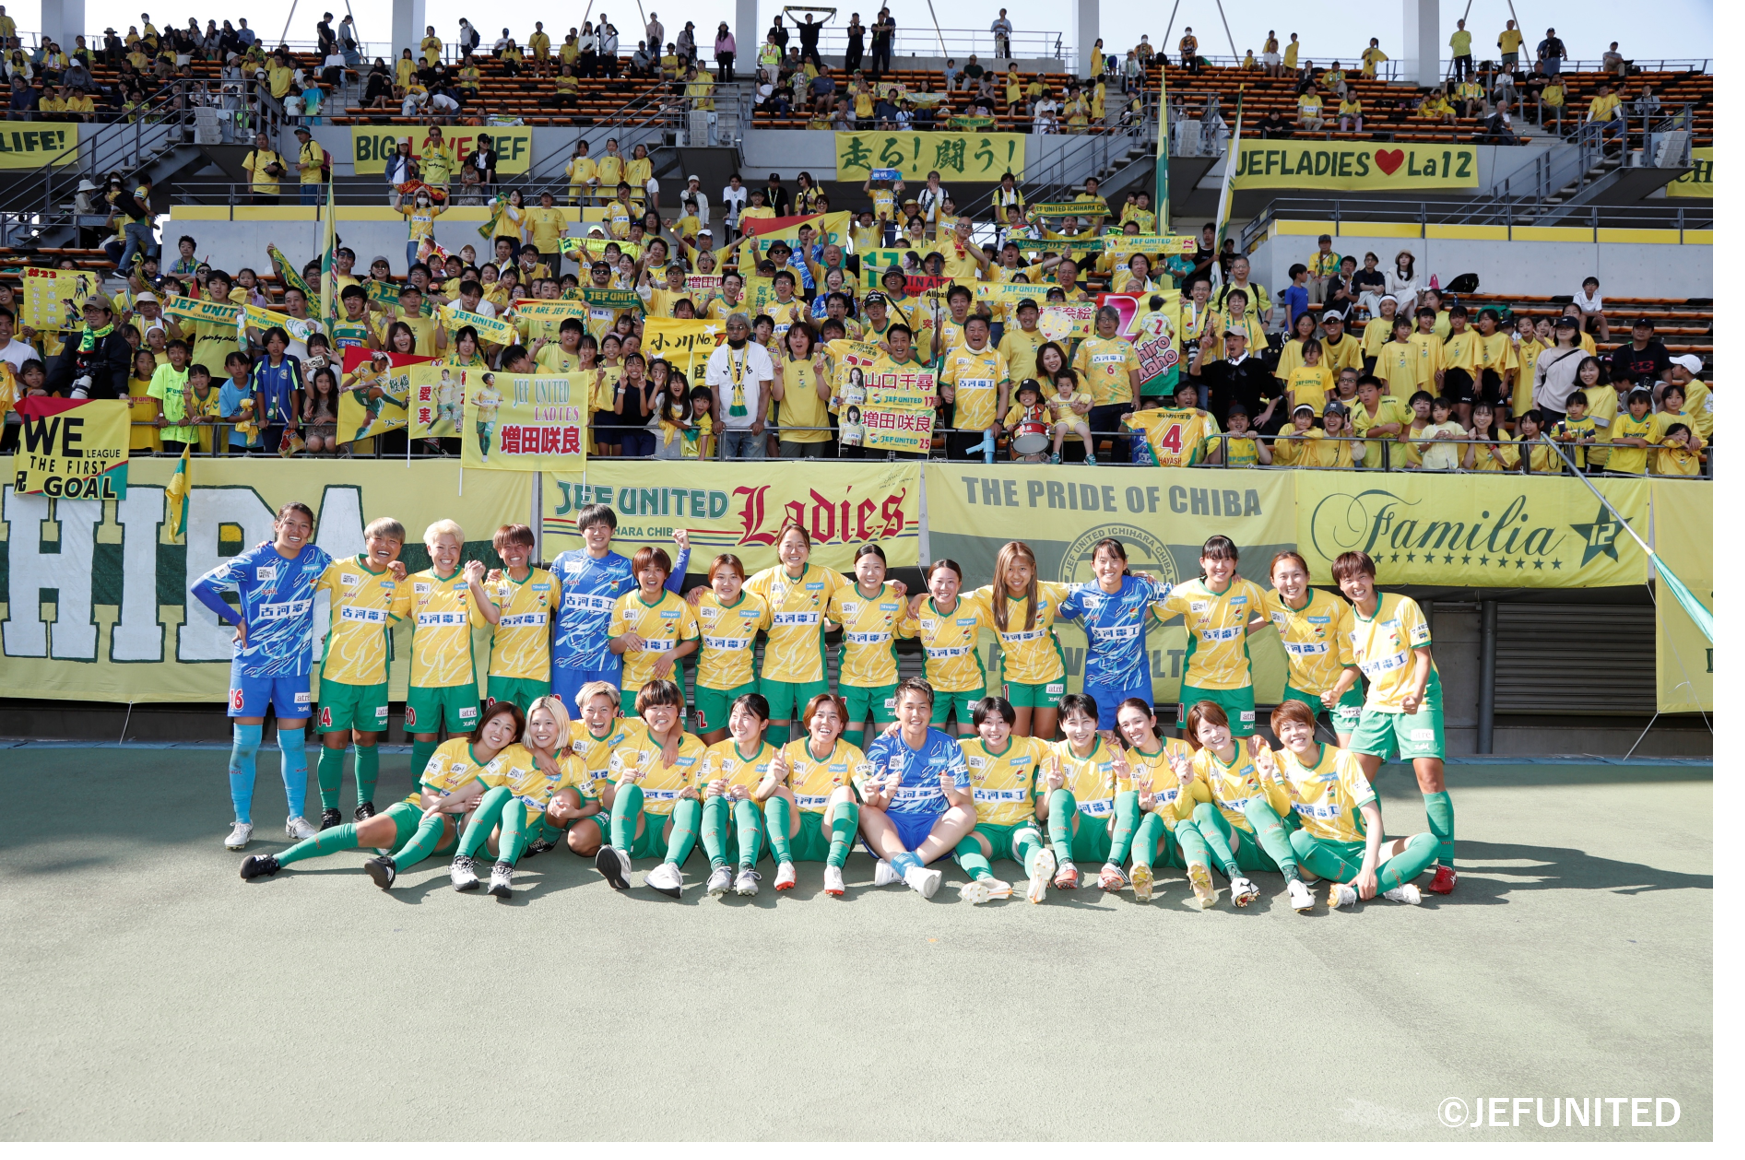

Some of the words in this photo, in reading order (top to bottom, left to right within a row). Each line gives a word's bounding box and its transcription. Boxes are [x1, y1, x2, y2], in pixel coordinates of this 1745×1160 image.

[0, 131, 65, 152] LIFE!
[356, 135, 396, 161] BIG
[1236, 149, 1370, 176] JEFLADIES
[1043, 204, 1067, 212] UNITED
[28, 268, 57, 279] #23
[589, 291, 608, 301] JEF
[610, 291, 639, 300] UNITE
[1001, 285, 1018, 293] JEF
[1019, 285, 1048, 293] UNITED
[169, 298, 199, 311] JEF
[535, 306, 550, 314] ARE
[551, 307, 565, 315] JEF
[566, 307, 583, 316] FAM
[257, 317, 284, 329] UNITED
[452, 309, 472, 322] JEF
[472, 314, 506, 331] UNITED
[1083, 324, 1090, 334] 4
[651, 333, 694, 352] 小川
[696, 333, 712, 345] No.
[714, 334, 727, 347] 7
[1107, 364, 1115, 375] 6
[865, 372, 933, 390] 山口千尋
[959, 380, 994, 388] 古河電工
[513, 379, 529, 408] JEF
[535, 379, 570, 405] UNITED
[898, 396, 922, 404] UNITED
[924, 396, 934, 407] 17
[534, 406, 579, 422] LADIES
[862, 411, 931, 433] 増田咲良
[24, 413, 84, 458] WE
[501, 425, 581, 455] 増田咲良
[880, 435, 894, 444] JEF
[894, 436, 918, 445] UNITED
[919, 438, 930, 450] 25
[1161, 423, 1183, 454] 4
[86, 449, 121, 458] LEAGUE
[30, 455, 56, 473] THE
[67, 460, 107, 475] FIRST
[43, 476, 116, 499] GOAL
[961, 476, 1020, 507] THE
[1027, 480, 1117, 512] PRIDE
[1126, 486, 1160, 513] OF
[1169, 485, 1262, 516] CHIBA
[554, 479, 614, 516] JEF
[617, 487, 729, 519] UNITED
[732, 484, 907, 546] Ladies
[615, 526, 644, 537] HARA
[647, 526, 677, 537] CHIB
[1311, 489, 1567, 562] Familia
[1589, 522, 1616, 547] 12
[1065, 553, 1076, 572] JEF
[1074, 529, 1106, 553] UNITED
[1107, 526, 1156, 547] ICHIHARA
[1155, 545, 1174, 576] CHIBA
[566, 594, 614, 611] 古河電工
[343, 607, 388, 622] 古河電工
[418, 613, 467, 626] 古河電工
[501, 614, 547, 627] 古河電工
[774, 613, 819, 625] 古河電工
[847, 632, 890, 642] 古河電工
[1093, 626, 1139, 639] 古河電工
[704, 638, 749, 649] 古河電工
[1048, 685, 1064, 693] atré
[974, 789, 1026, 801] 古河電工
